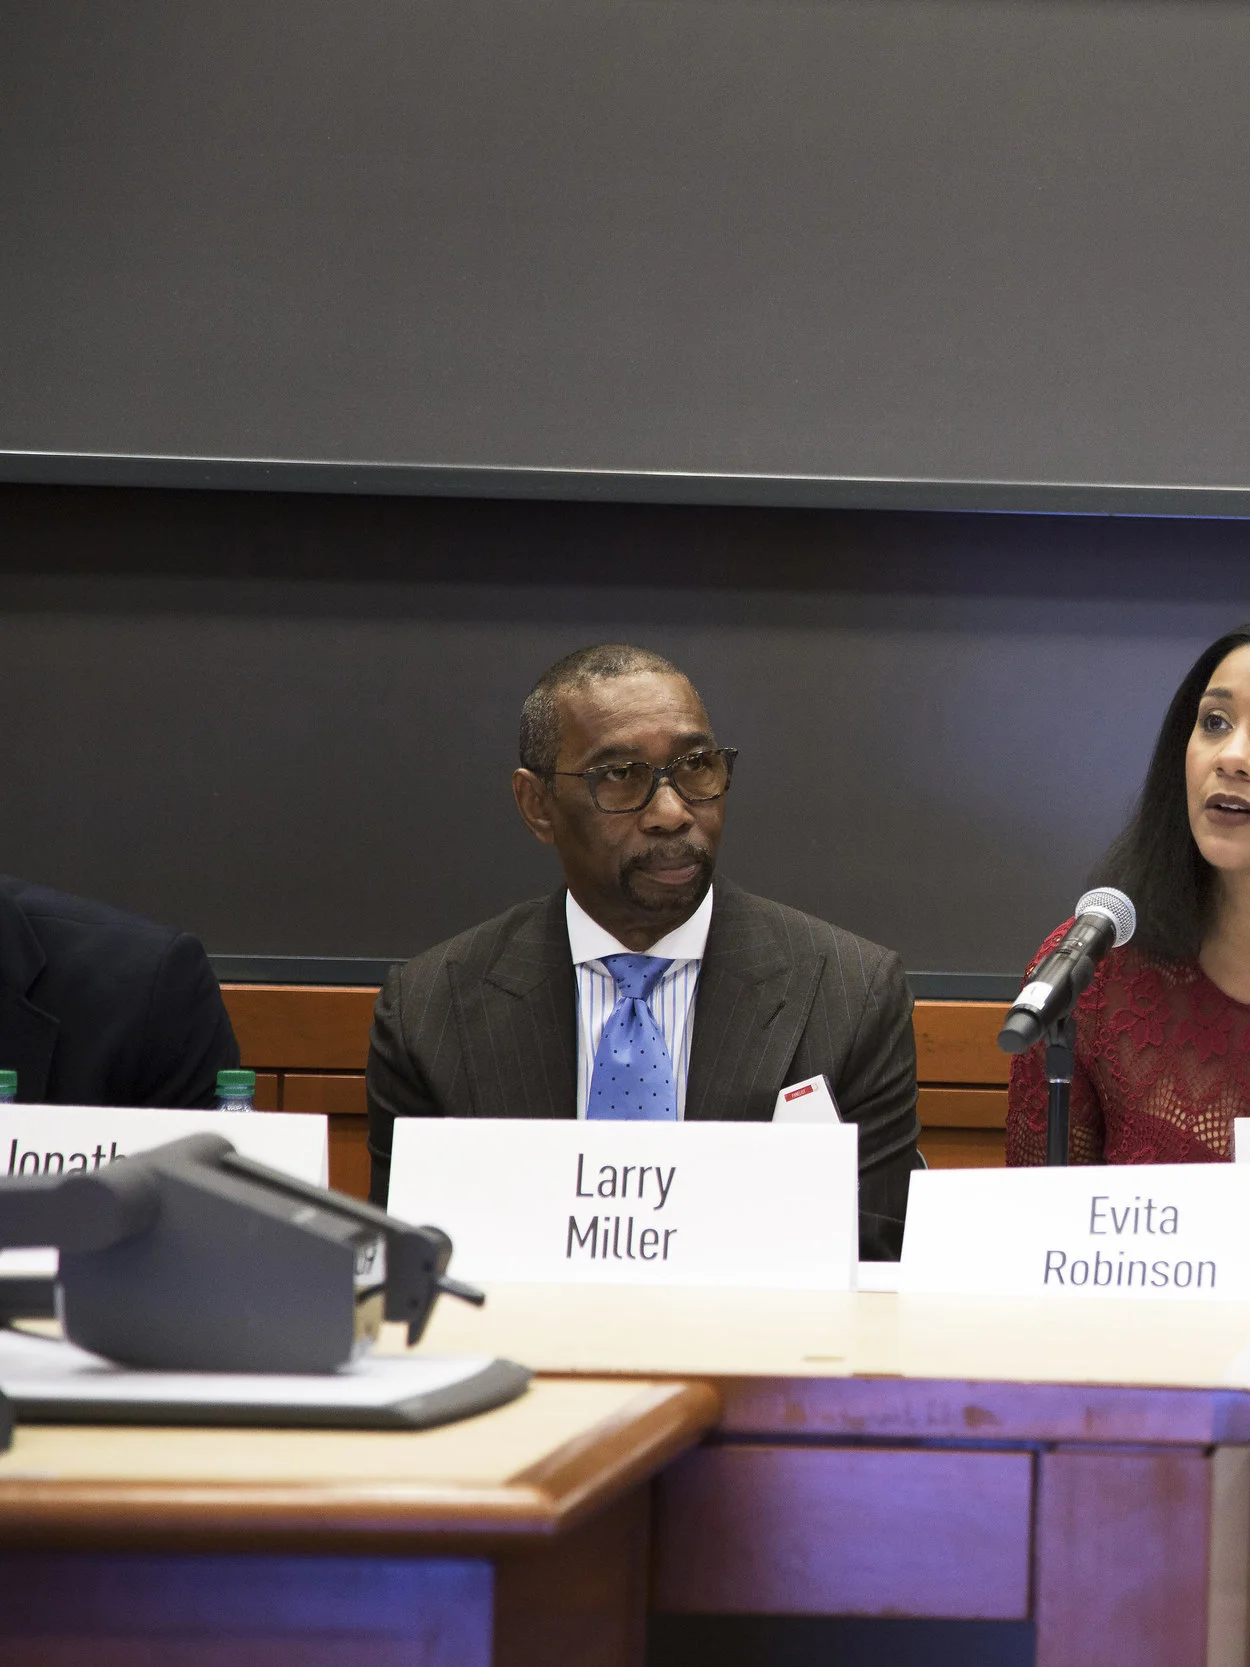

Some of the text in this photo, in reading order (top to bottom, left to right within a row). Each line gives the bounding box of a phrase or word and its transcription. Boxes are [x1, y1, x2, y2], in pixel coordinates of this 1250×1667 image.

[575, 1153, 677, 1211] Larry
[1089, 1196, 1179, 1235] Evita
[566, 1215, 678, 1261] Miller
[1043, 1250, 1216, 1288] Robinson
